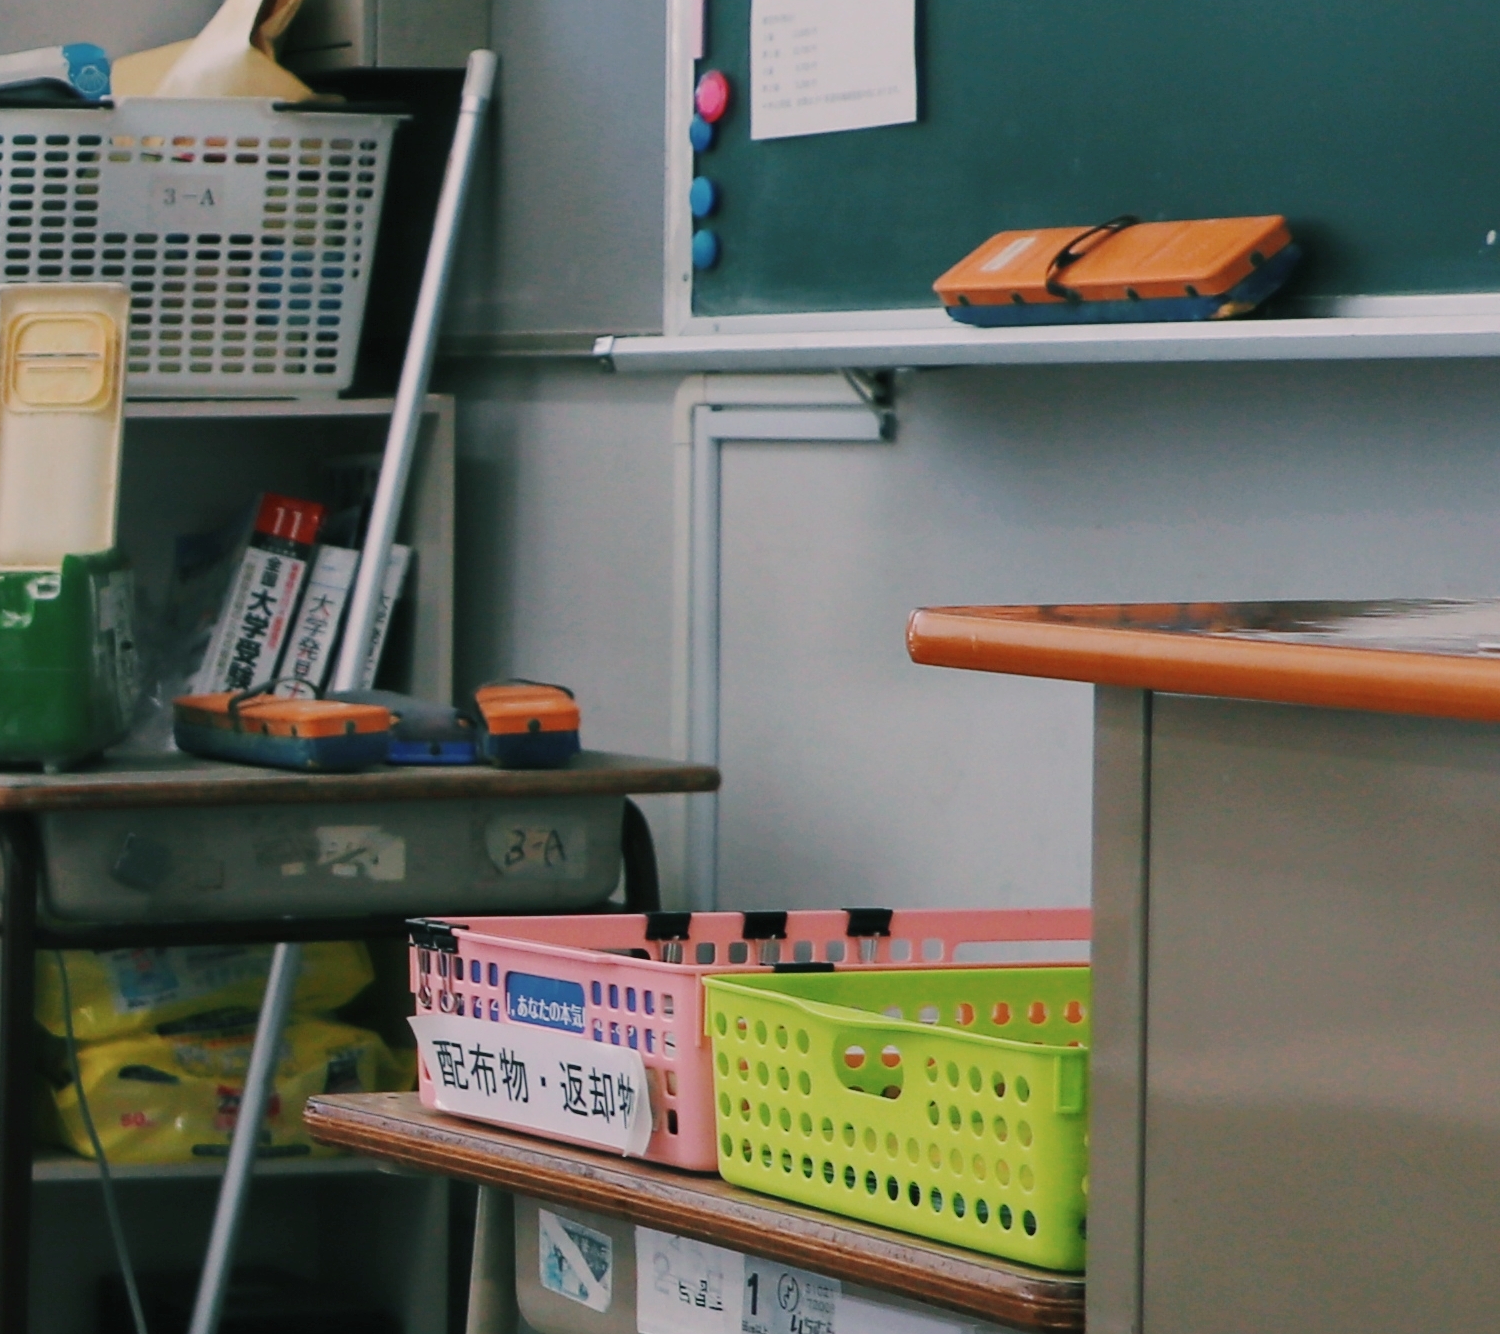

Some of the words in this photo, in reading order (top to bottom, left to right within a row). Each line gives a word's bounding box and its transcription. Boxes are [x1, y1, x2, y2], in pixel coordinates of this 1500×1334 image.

[163, 187, 215, 206] 3-A
[272, 506, 302, 540] 11
[432, 1040, 635, 1129] 配布物・返却物
[747, 1273, 759, 1316] 1
